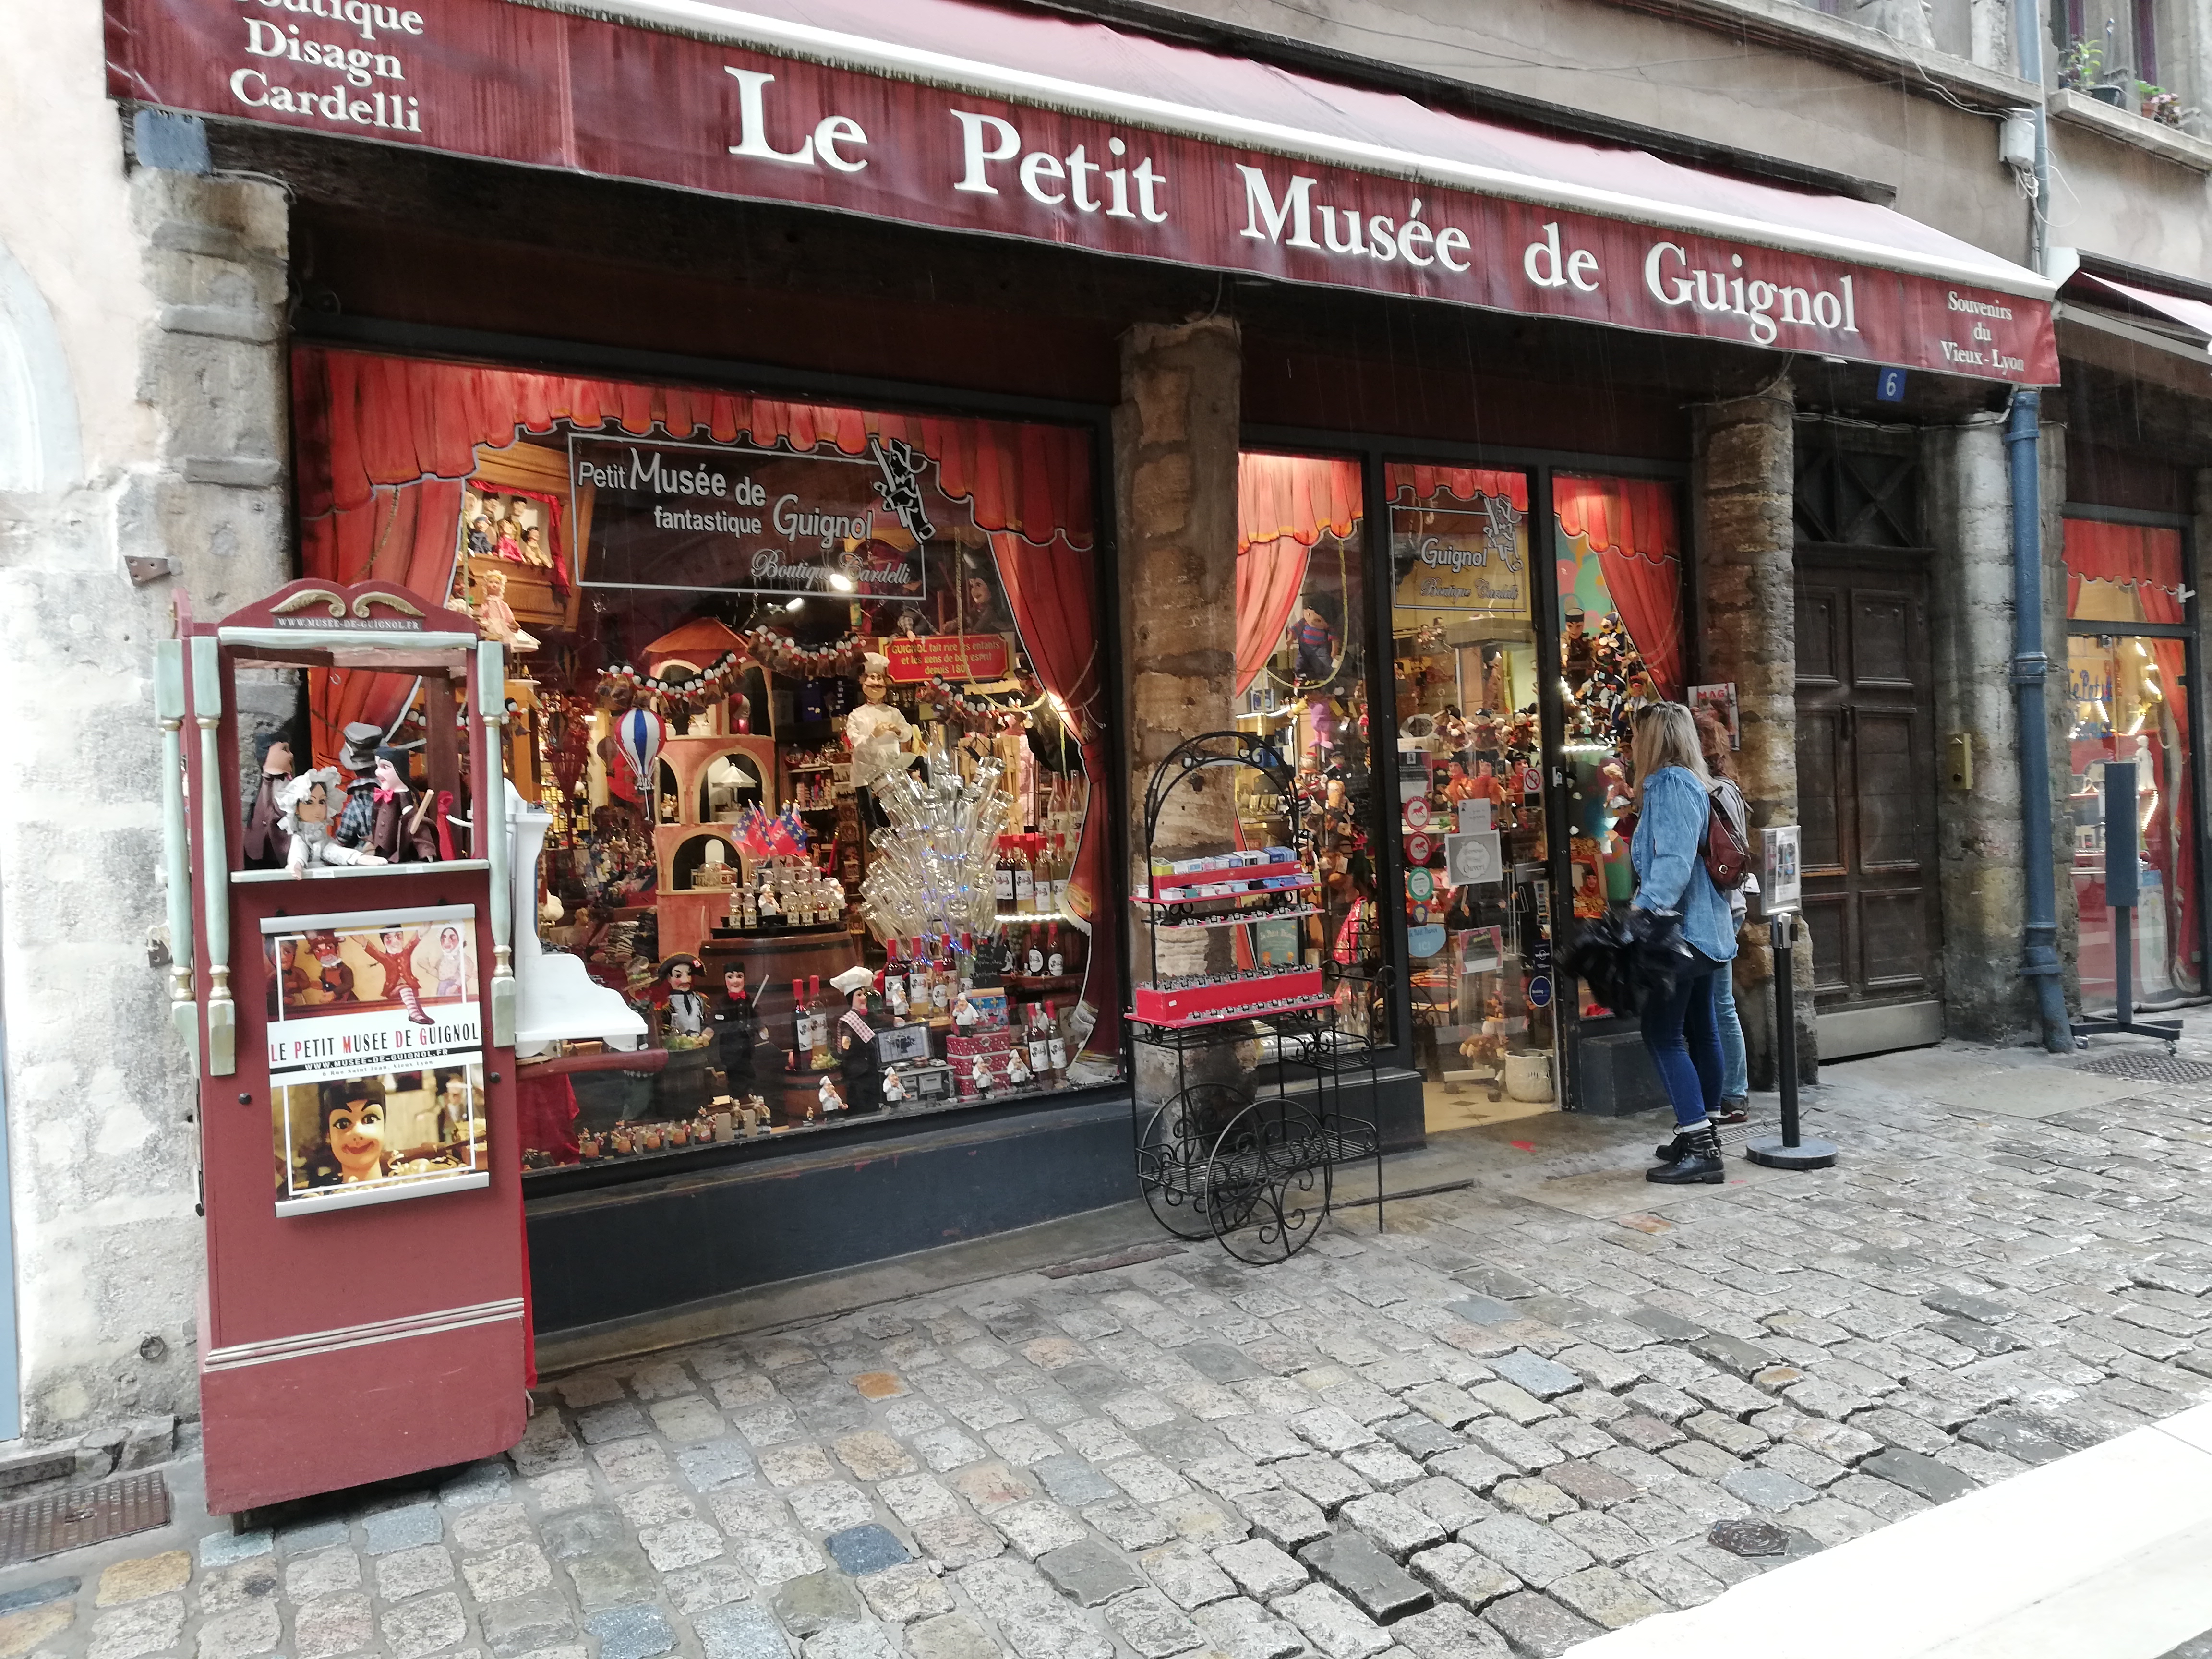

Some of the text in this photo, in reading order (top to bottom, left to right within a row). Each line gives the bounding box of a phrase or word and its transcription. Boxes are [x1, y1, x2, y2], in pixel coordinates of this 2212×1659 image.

[237, 0, 424, 40] utique
[242, 17, 406, 88] Disagn
[229, 68, 423, 133] Cardelli
[724, 65, 1860, 345] Le Petit Musée de Guignol
[1948, 290, 2013, 321] Souvenirs
[1973, 322, 1992, 341] du
[1886, 373, 1898, 396] 6
[577, 447, 767, 507] Petit Musée de
[653, 493, 874, 549] fantastique Guignol
[750, 548, 911, 590] Boutique Cardelli
[1421, 537, 1488, 573] Guignol
[1420, 577, 1472, 604] Boutique
[277, 617, 420, 630] WWW.MUSEE-DE-GUIGNOL.FR
[892, 643, 927, 654] GUIGNOL
[943, 643, 958, 651] rire
[972, 641, 1000, 650] enfants
[901, 656, 909, 664] et
[944, 653, 953, 662] de
[970, 651, 992, 661] esprit
[925, 665, 950, 675] depuis
[270, 1022, 479, 1062] LE PETIT MUSEE DE GUIGNOL
[304, 1048, 449, 1071] WWW.MUSEE-DE-GUIGNOL.FR
